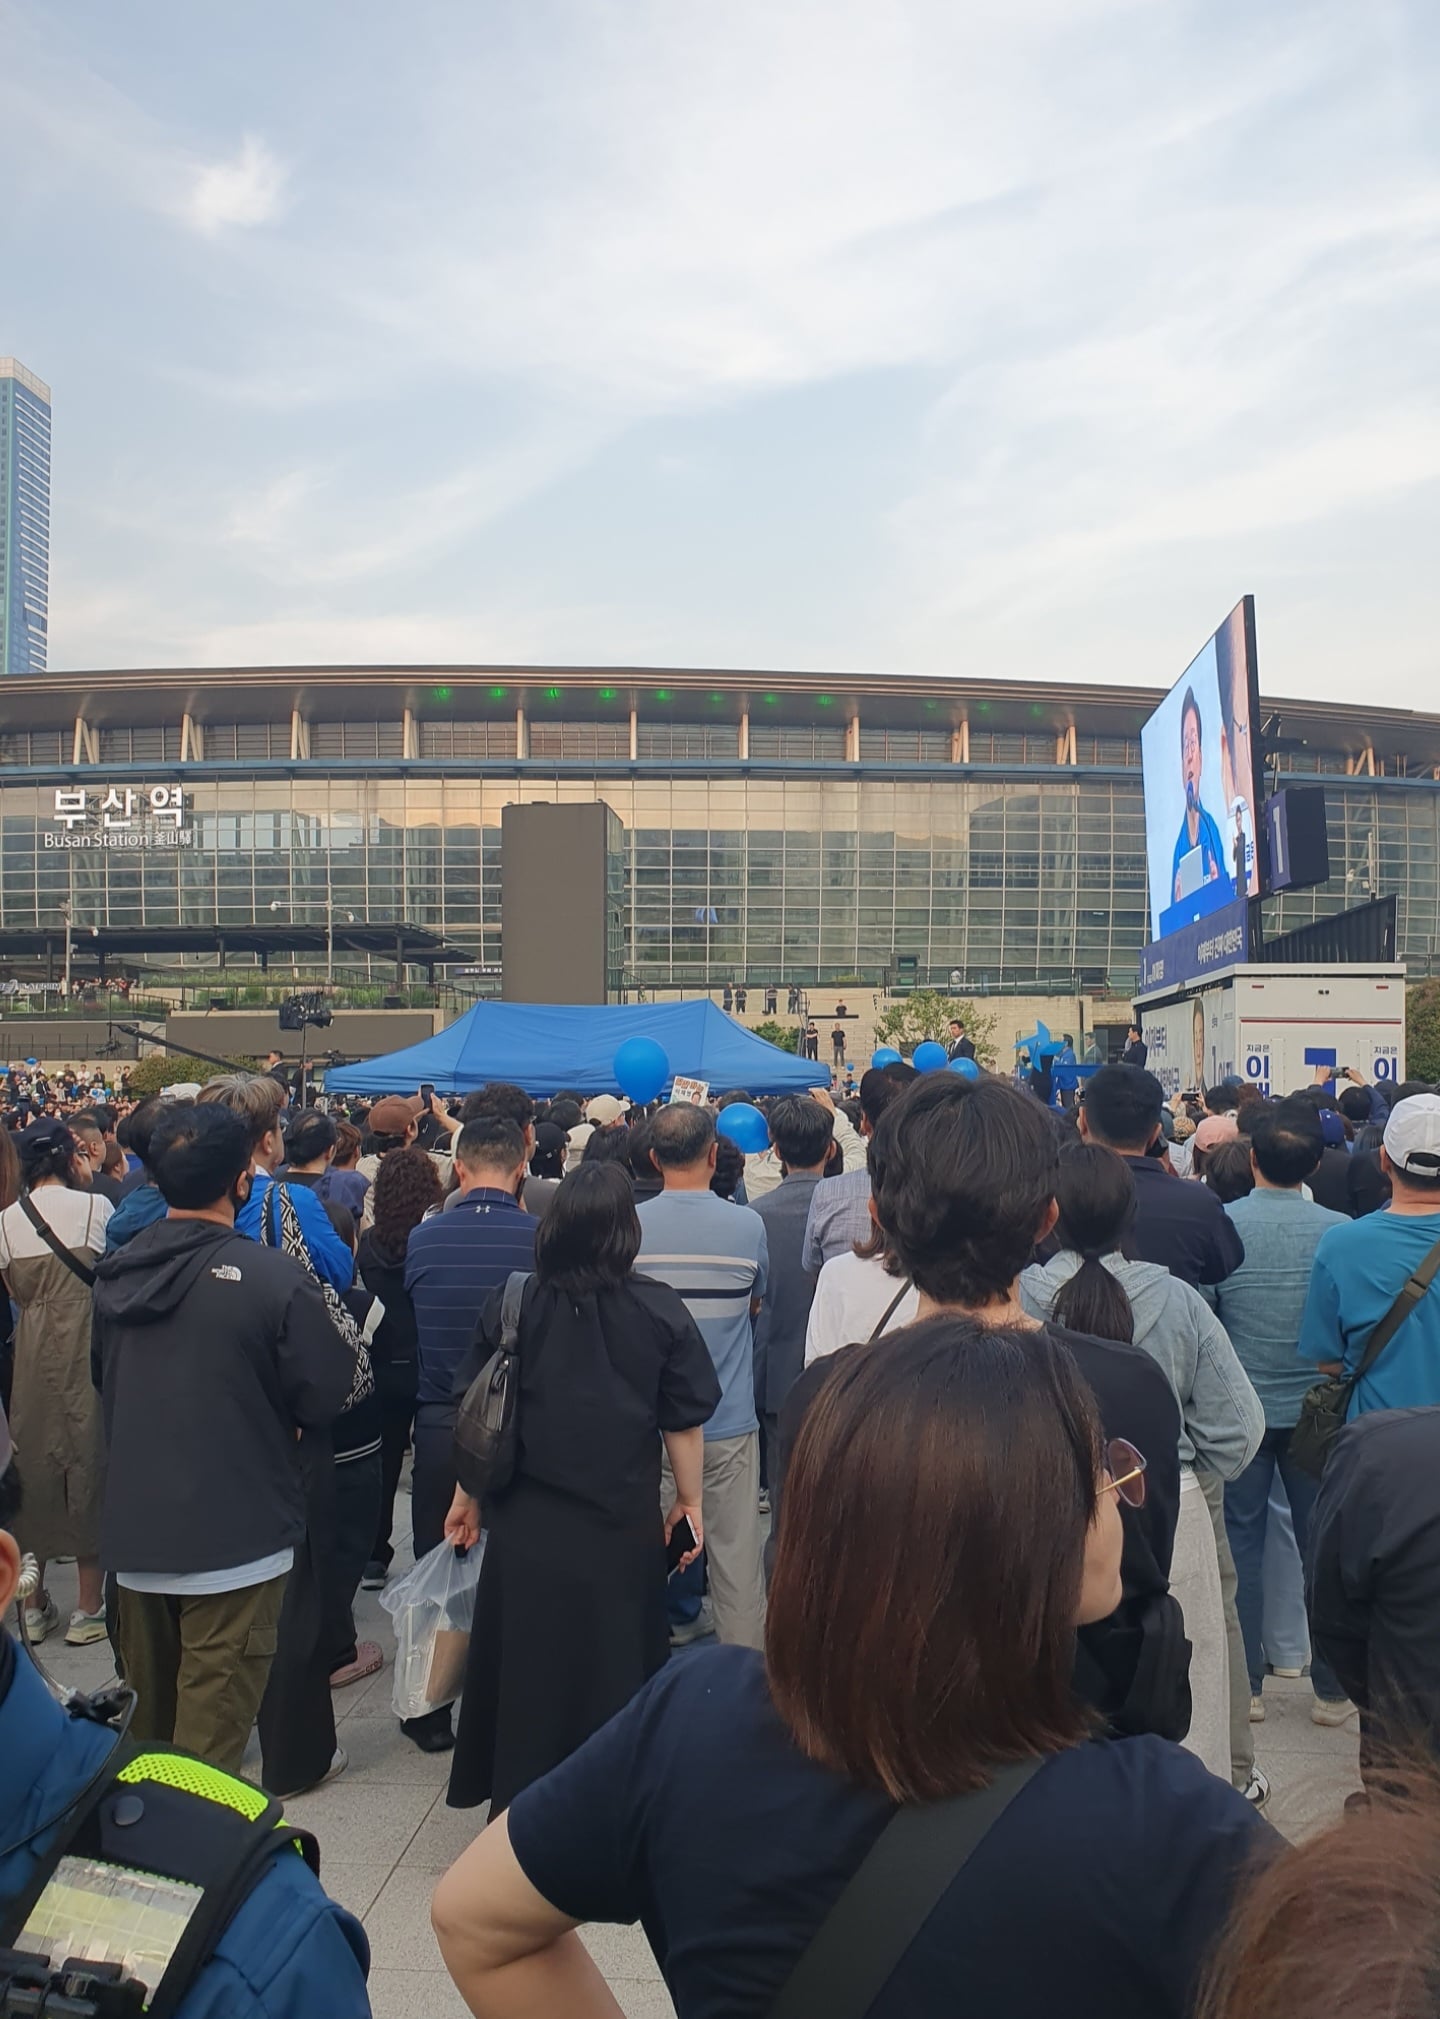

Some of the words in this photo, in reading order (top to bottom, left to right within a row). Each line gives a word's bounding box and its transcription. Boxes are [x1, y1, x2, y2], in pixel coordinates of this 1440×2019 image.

[53, 786, 182, 829] 부산역
[44, 832, 91, 848] Busan
[94, 831, 149, 847] Station
[1273, 805, 1284, 874] 1
[1246, 1044, 1270, 1053] 지금은
[1374, 1046, 1398, 1054] 지금은
